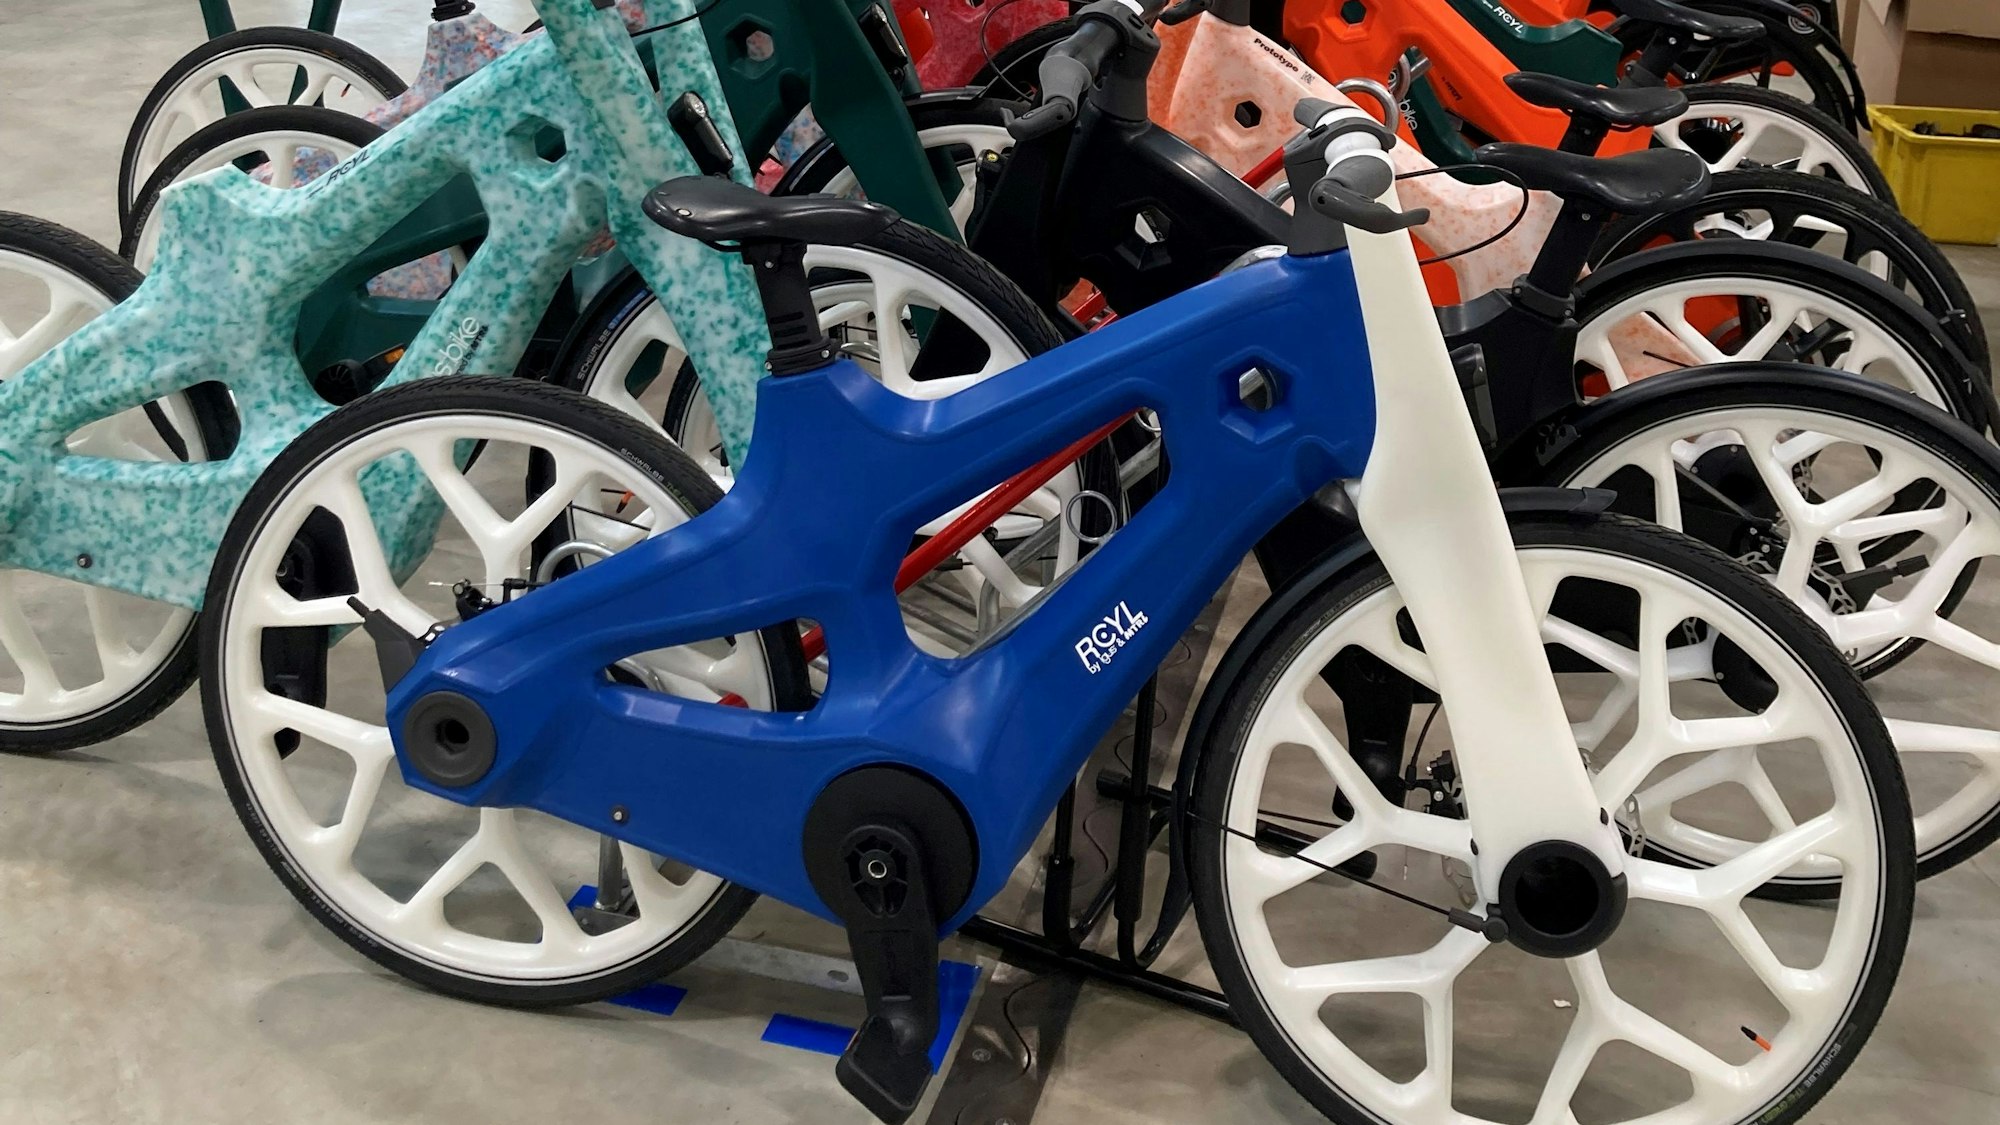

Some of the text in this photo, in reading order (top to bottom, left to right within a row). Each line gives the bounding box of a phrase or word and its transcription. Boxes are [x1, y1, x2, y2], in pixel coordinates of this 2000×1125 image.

[1493, 6, 1524, 34] RCYL
[1253, 37, 1299, 72] Prototype
[325, 149, 370, 186] RCYL
[577, 328, 612, 381] SCHWALBE
[620, 447, 665, 482] SCHWALBE
[1074, 600, 1144, 668] RCYL
[1087, 661, 1101, 675] by
[1116, 637, 1126, 647] &
[1802, 1042, 1842, 1088] SCHWALBE
